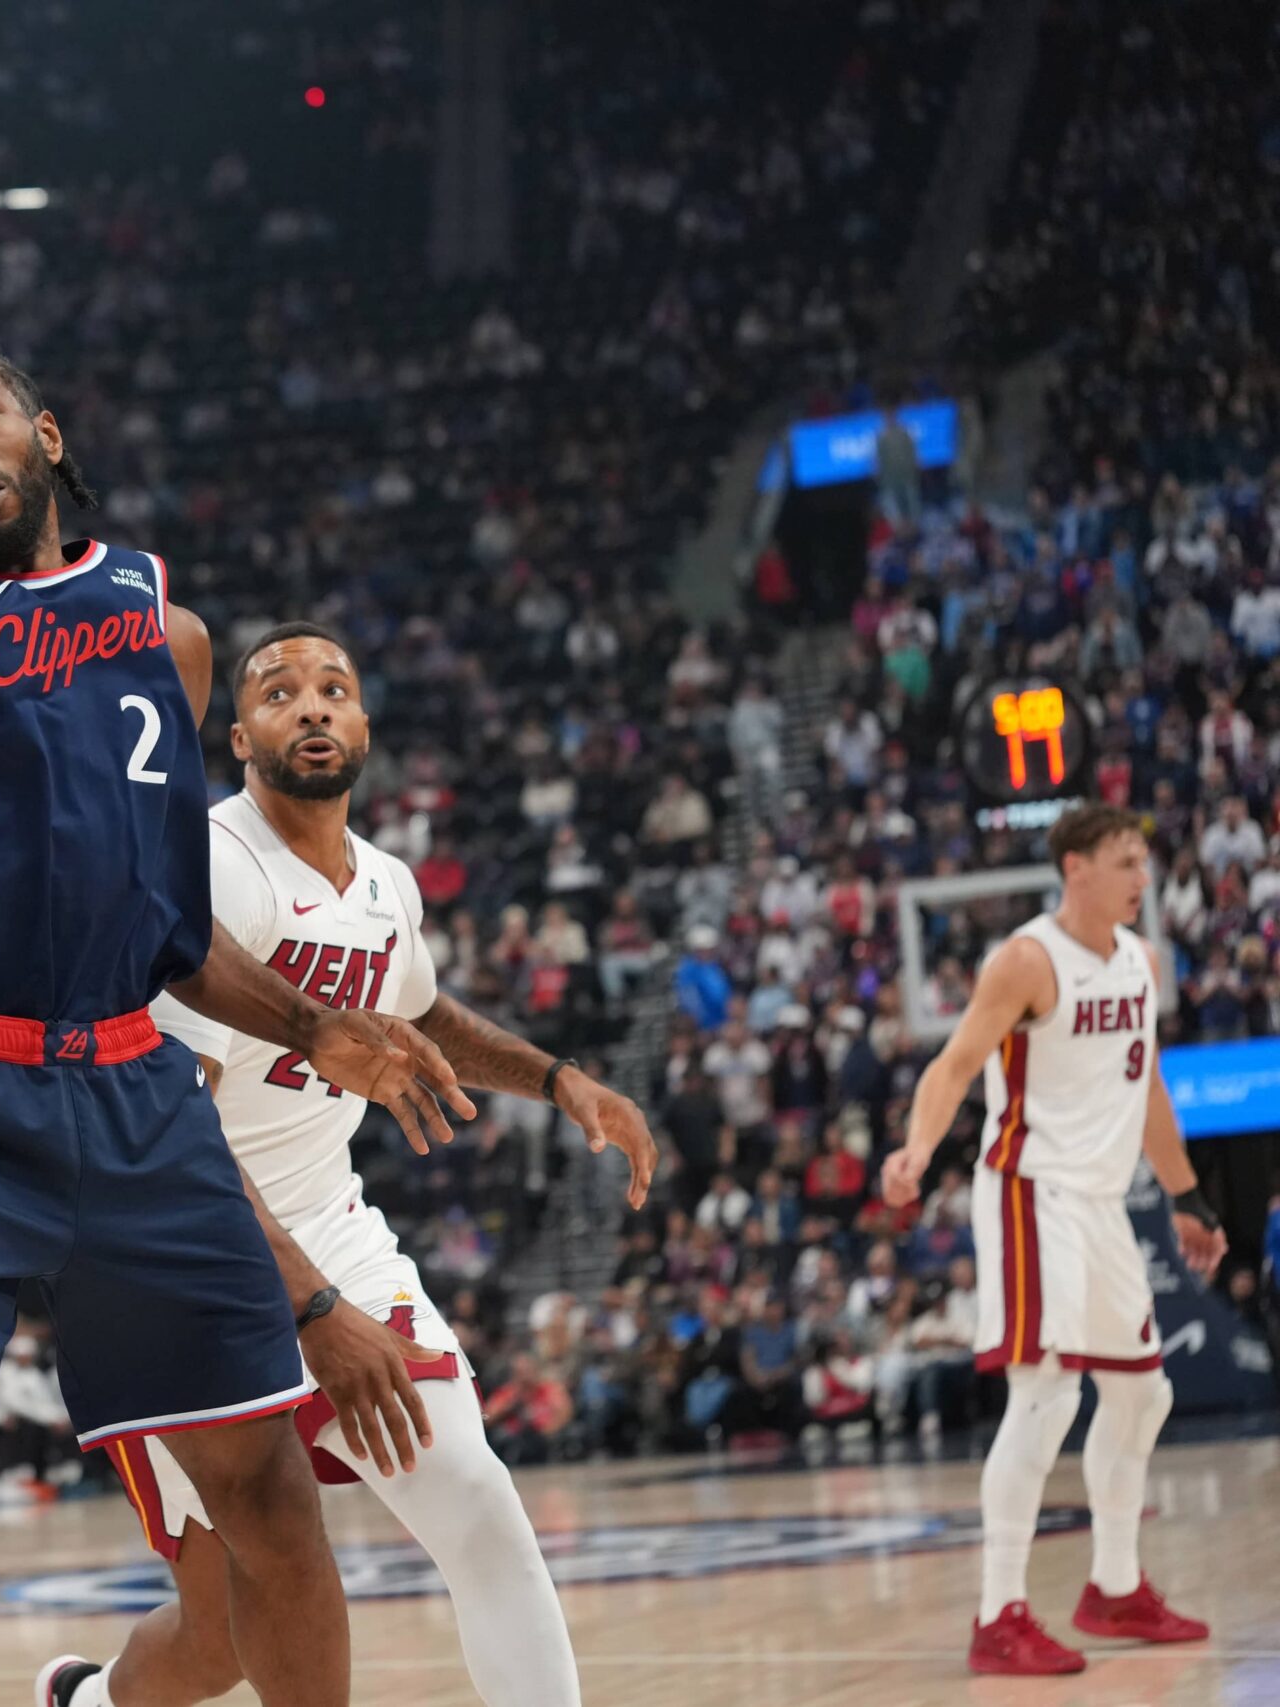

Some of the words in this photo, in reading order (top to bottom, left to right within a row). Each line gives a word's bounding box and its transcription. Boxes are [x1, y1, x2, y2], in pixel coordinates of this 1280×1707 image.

[110, 575, 155, 597] RWANDA
[116, 567, 144, 582] VISIT
[119, 694, 169, 785] 2
[266, 928, 398, 1011] HEAT
[1071, 984, 1147, 1036] HEAT
[1124, 1038, 1145, 1082] 9
